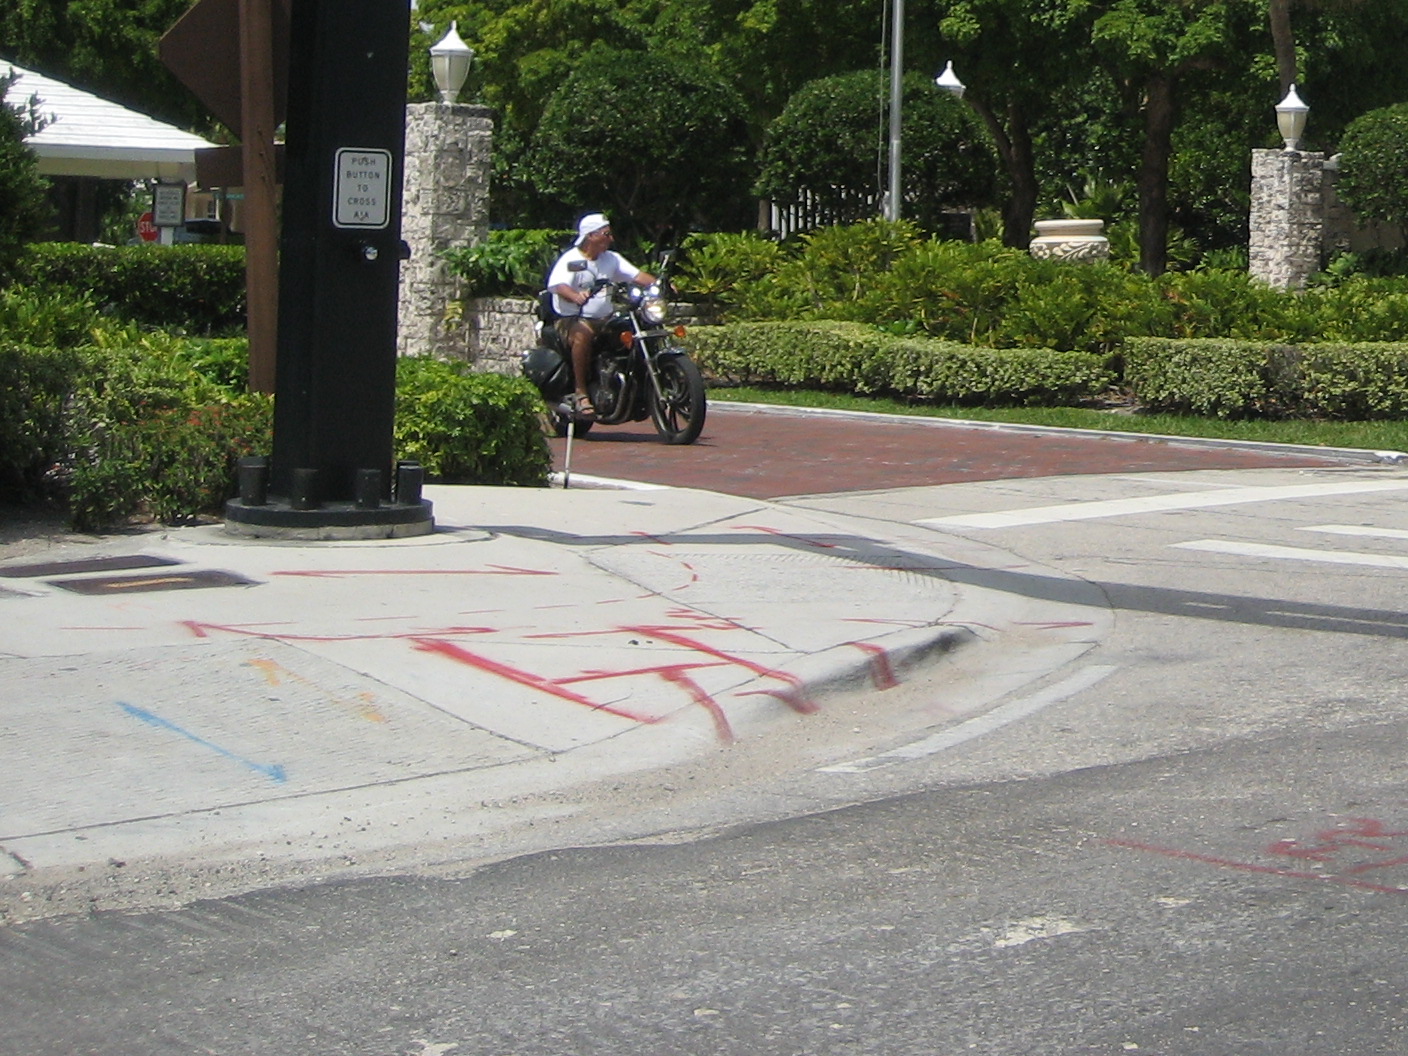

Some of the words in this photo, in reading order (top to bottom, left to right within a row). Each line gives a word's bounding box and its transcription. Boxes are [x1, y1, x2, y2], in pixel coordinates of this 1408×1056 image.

[351, 157, 376, 165] PUSH
[346, 170, 380, 179] BUTTON
[357, 184, 369, 192] TO
[347, 197, 376, 206] CROSS
